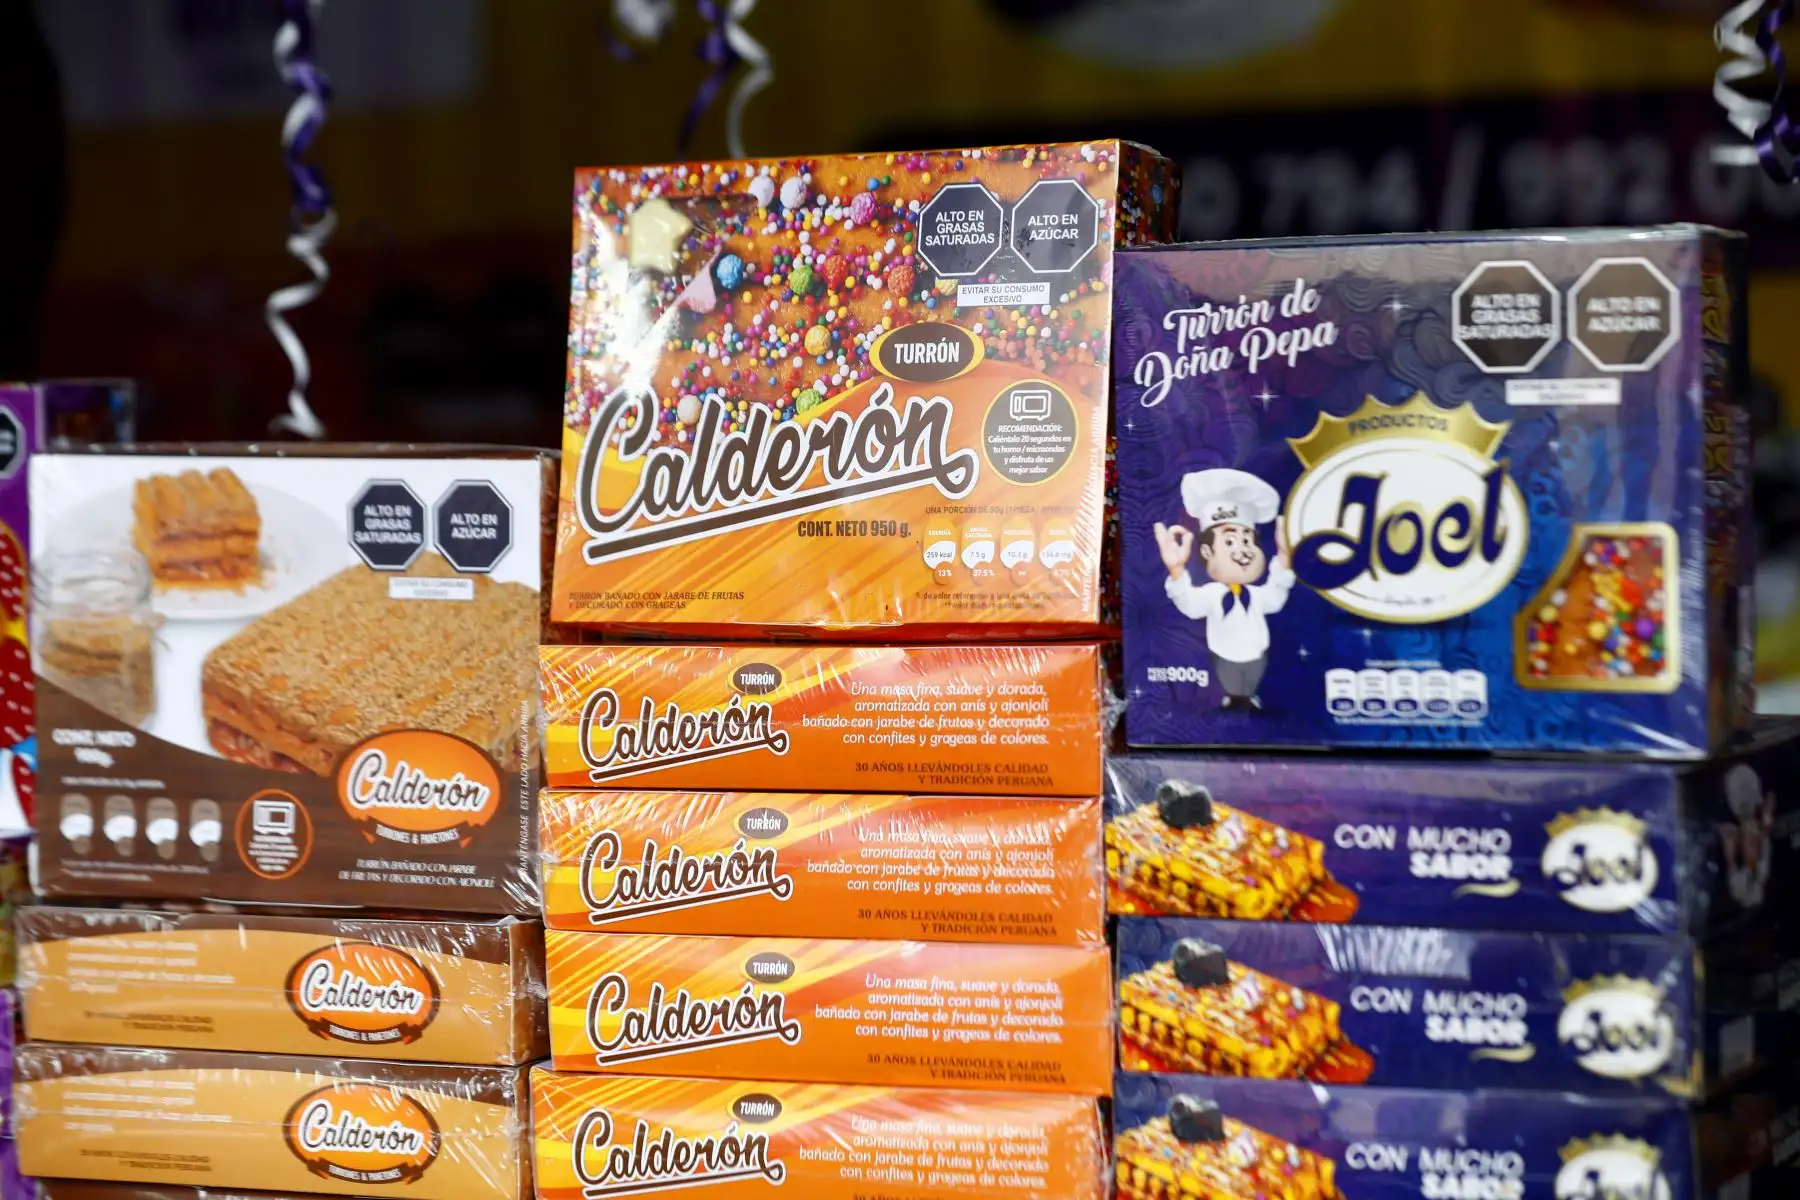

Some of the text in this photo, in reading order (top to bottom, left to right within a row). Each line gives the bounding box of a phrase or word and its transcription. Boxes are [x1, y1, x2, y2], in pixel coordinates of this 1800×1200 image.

[935, 210, 984, 223] ALTO EN
[1028, 214, 1079, 226] ALTO EN
[937, 222, 985, 234] GRASAS
[1029, 226, 1079, 241] AZÚCAR
[925, 232, 995, 246] SATURADAS
[962, 284, 1045, 295] EVITAR SU CONSUMO
[983, 295, 1022, 304] EXCESIVO
[1163, 277, 1322, 354] Turrón de
[894, 337, 960, 364] TURRÓN
[1134, 321, 1340, 408] Doña Pepa
[998, 423, 1063, 433] RECOMENDACIÓN:
[1347, 413, 1450, 436] PRODUCTOS
[988, 433, 1061, 445] Caliéntalo segundos
[575, 382, 980, 545] Calderón
[1009, 454, 1034, 464] disfruta
[1008, 465, 1049, 475] mejor sabor
[364, 505, 412, 517] ALTO EN
[925, 507, 942, 515] UNA
[364, 518, 411, 530] GRASAS
[451, 513, 498, 525] ALTO EN
[1291, 457, 1511, 592] Joel
[451, 524, 497, 539] AZÚCAR
[797, 521, 833, 537] CONT.
[836, 520, 867, 536] NETO
[870, 520, 897, 536] 950
[900, 523, 912, 538] g.
[354, 531, 422, 544] SATURADAS
[926, 551, 953, 559] 259 kcal
[642, 592, 661, 600] CON
[663, 591, 696, 601] JARABE
[697, 592, 710, 600] DE
[712, 591, 744, 600] FRUTAS
[625, 601, 643, 609] CON
[646, 601, 686, 609] GRAGEAS
[741, 672, 775, 686] TURRÓN
[1167, 667, 1209, 687] 900g
[851, 682, 877, 695] Una
[946, 685, 983, 696] suave
[855, 698, 930, 712] aromatizada
[934, 701, 956, 712] con
[961, 699, 986, 712] anís
[990, 702, 997, 715] y
[802, 714, 1050, 731] bañado con jarabe de frutas y decorado
[579, 688, 790, 774] Calderón
[843, 731, 1050, 748] con confites y grageas de colores.
[855, 759, 1048, 774] 30 AÑOS LLEVÁNDOLES CALIDAD
[347, 748, 492, 812] Calderón
[520, 762, 529, 789] LADO
[919, 773, 1054, 787] Y TRADICIÓN PERUANA
[520, 790, 529, 810] ESTE
[746, 816, 781, 830] TURRÓN
[1334, 824, 1512, 852] CON MUCHO
[861, 846, 936, 860] aromatizada
[580, 829, 794, 916] Calderón
[856, 863, 878, 874] con
[924, 862, 940, 876] de
[1409, 852, 1513, 880] SABOR
[847, 879, 869, 890] con
[873, 878, 920, 894] confites
[986, 879, 1001, 893] de
[858, 909, 872, 919] 30
[753, 961, 788, 975] TURRÓN
[300, 959, 425, 1015] Calderón
[865, 973, 891, 988] Una
[895, 977, 927, 989] masa
[960, 979, 997, 992] suave
[948, 997, 970, 1008] con
[1350, 985, 1527, 1018] CON MUCHO
[586, 972, 801, 1058] Calderón
[815, 1004, 860, 1019] bañado
[864, 1009, 886, 1021] con
[889, 1008, 928, 1024] jarabe
[932, 1009, 948, 1023] de
[855, 1026, 877, 1037] con
[881, 1024, 928, 1040] confites
[994, 1027, 1010, 1041] de
[1424, 1016, 1528, 1044] SABOR
[740, 1100, 775, 1117] TURRÓN
[298, 1098, 425, 1155] Calderón
[573, 1108, 786, 1192] Calderón
[1345, 1142, 1525, 1177] CON MUCHO
